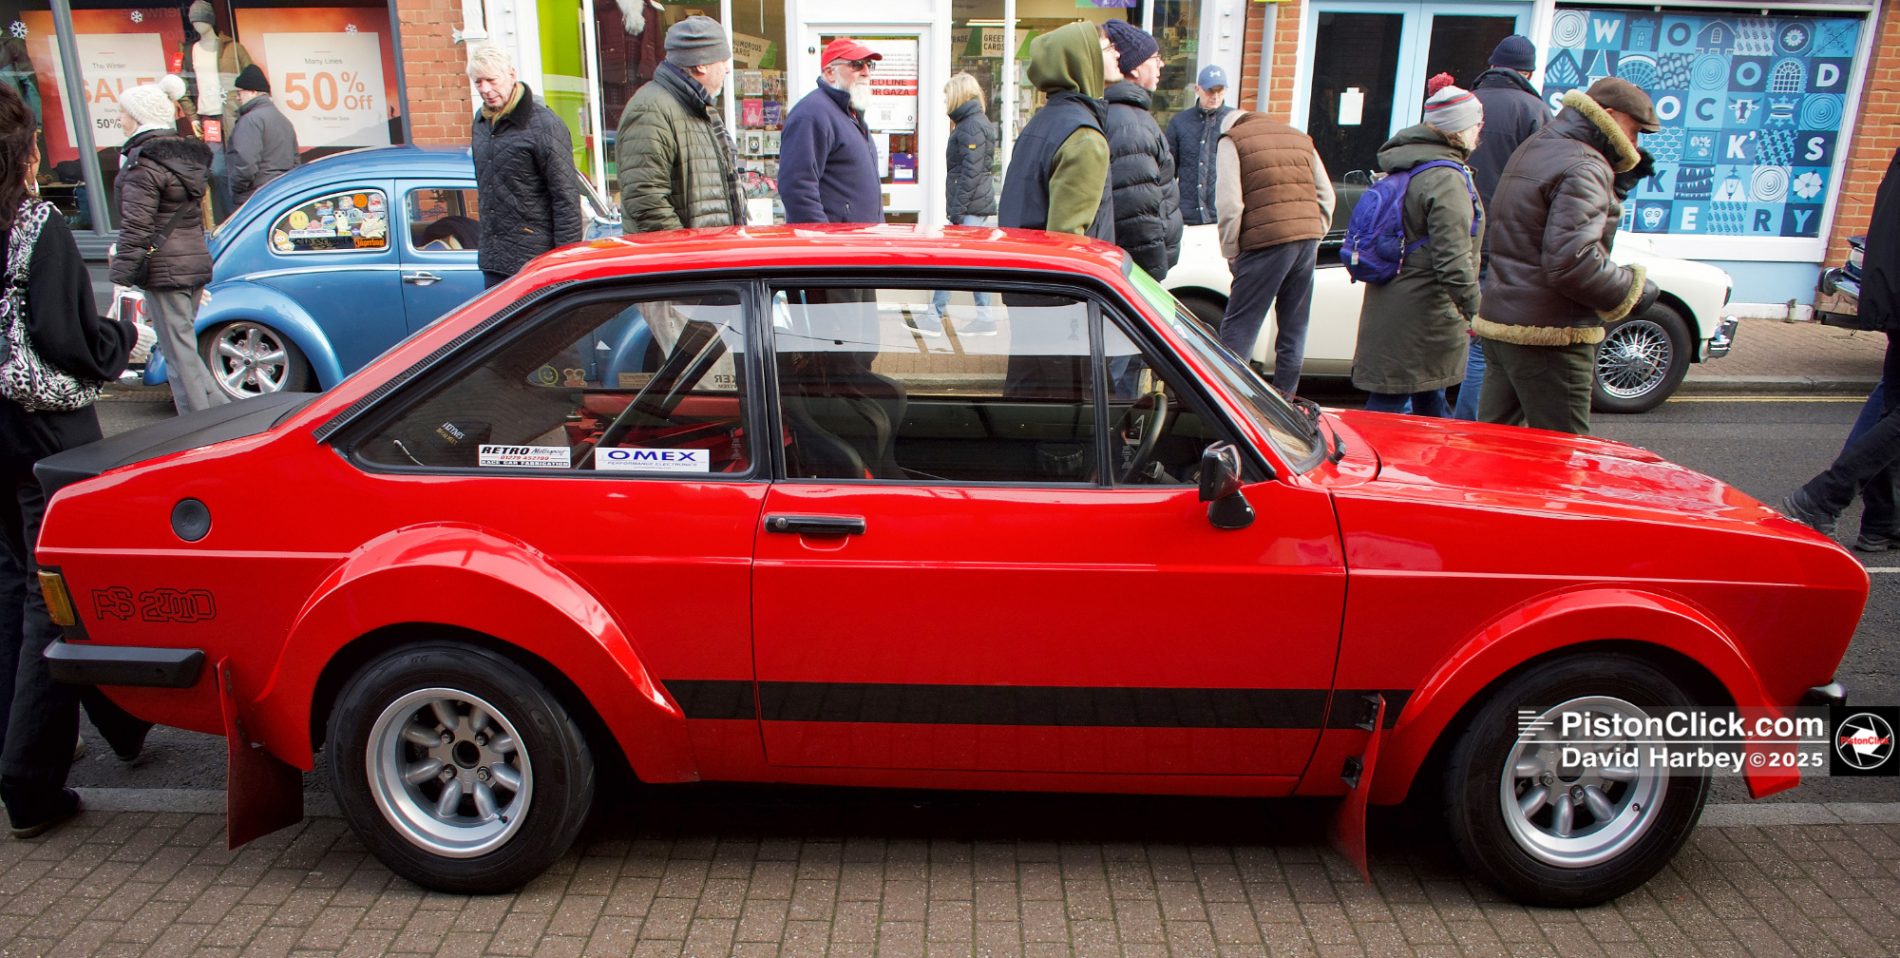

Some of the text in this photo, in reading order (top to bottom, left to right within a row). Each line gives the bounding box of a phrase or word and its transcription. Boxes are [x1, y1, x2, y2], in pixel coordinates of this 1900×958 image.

[883, 88, 910, 96] GAZA
[343, 95, 373, 110] Off
[96, 118, 122, 128] 50%
[481, 446, 530, 455] RETRO
[607, 450, 696, 462] OMEX
